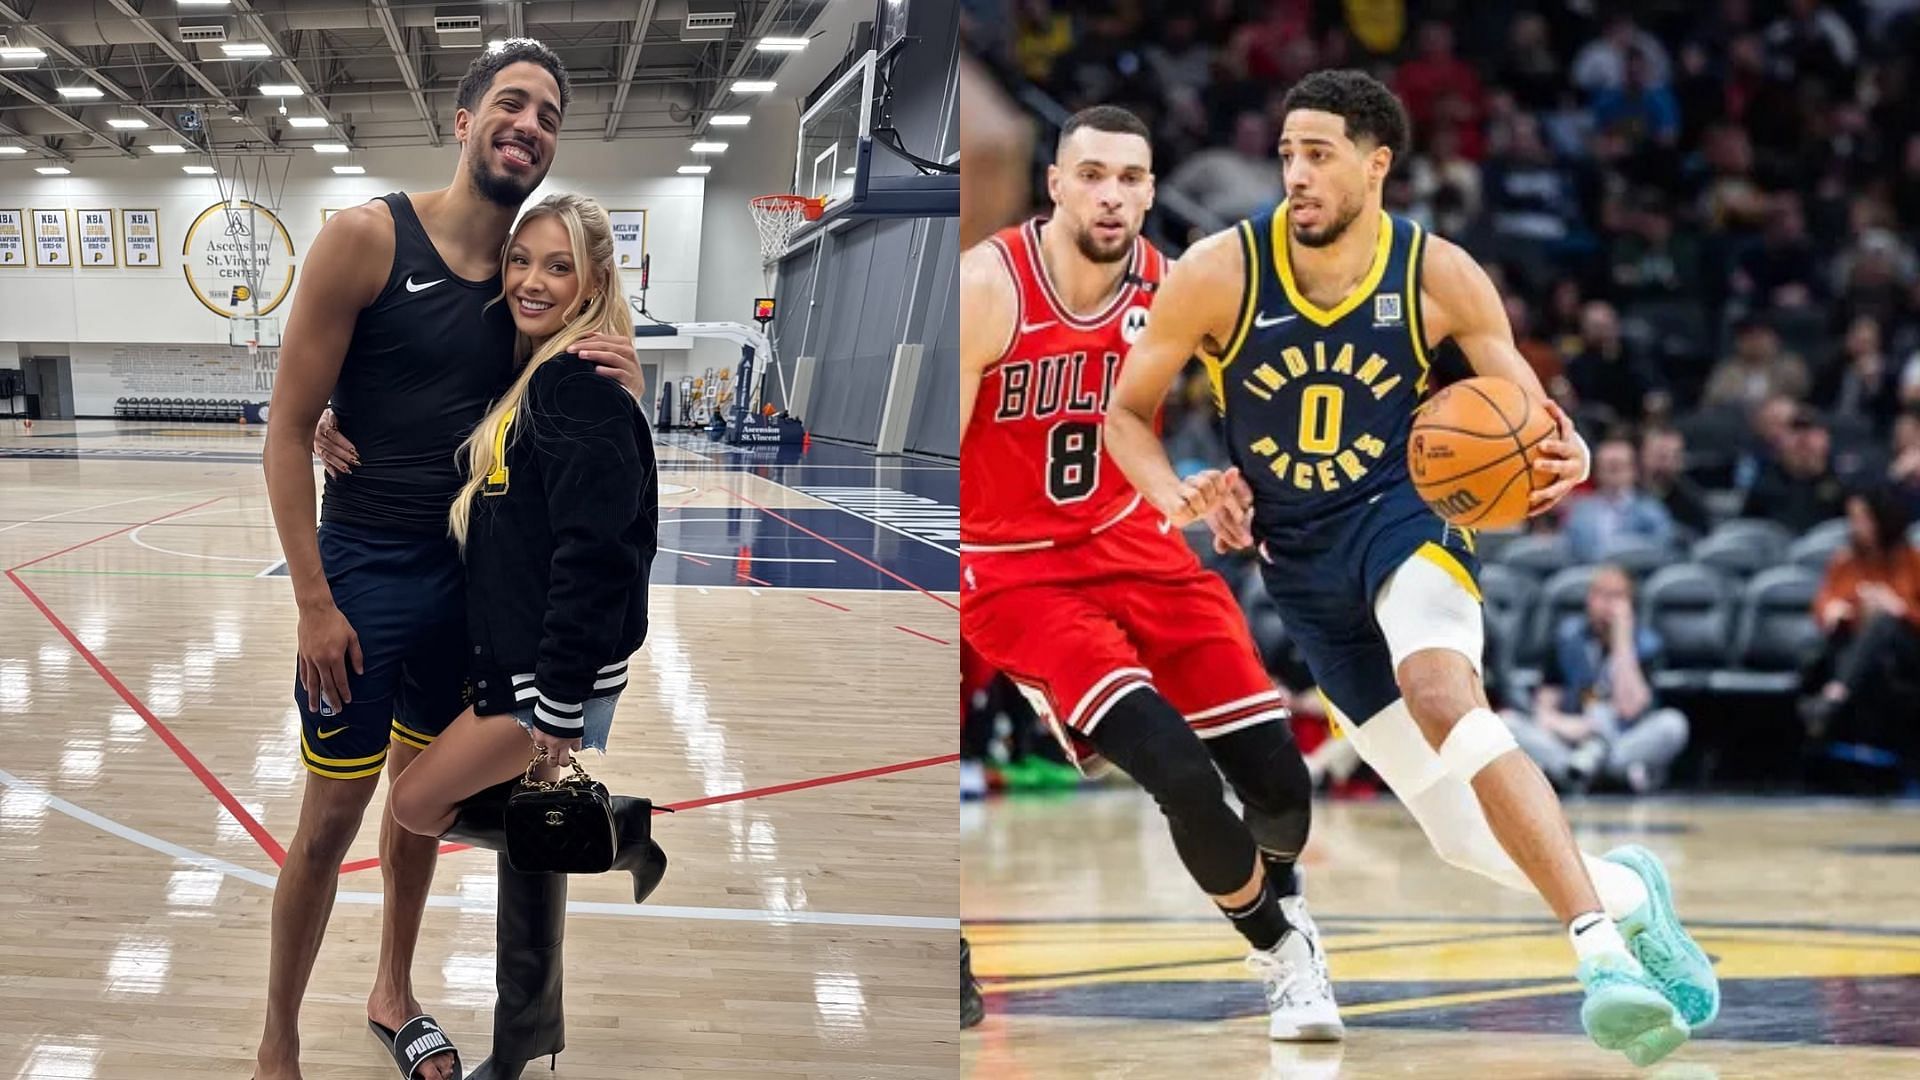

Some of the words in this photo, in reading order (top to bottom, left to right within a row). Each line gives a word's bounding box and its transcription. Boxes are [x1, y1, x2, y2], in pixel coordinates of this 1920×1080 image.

[42, 215, 58, 224] NBA
[86, 215, 103, 224] NBA
[131, 215, 148, 224] NBA
[206, 241, 268, 251] Ascenson
[206, 255, 222, 266] St.
[224, 255, 271, 266] Vincnt
[219, 269, 260, 278] CENTER
[253, 350, 279, 370] PAC
[1243, 341, 1402, 400] INDIANA
[996, 351, 1119, 422] BULL
[1298, 383, 1344, 455] 0
[742, 426, 780, 434] Ascension
[741, 434, 752, 442] St.
[752, 434, 780, 442] Vincent
[1046, 419, 1101, 505] 8
[1249, 433, 1386, 491] PACERS
[405, 1031, 446, 1062] PUMA
